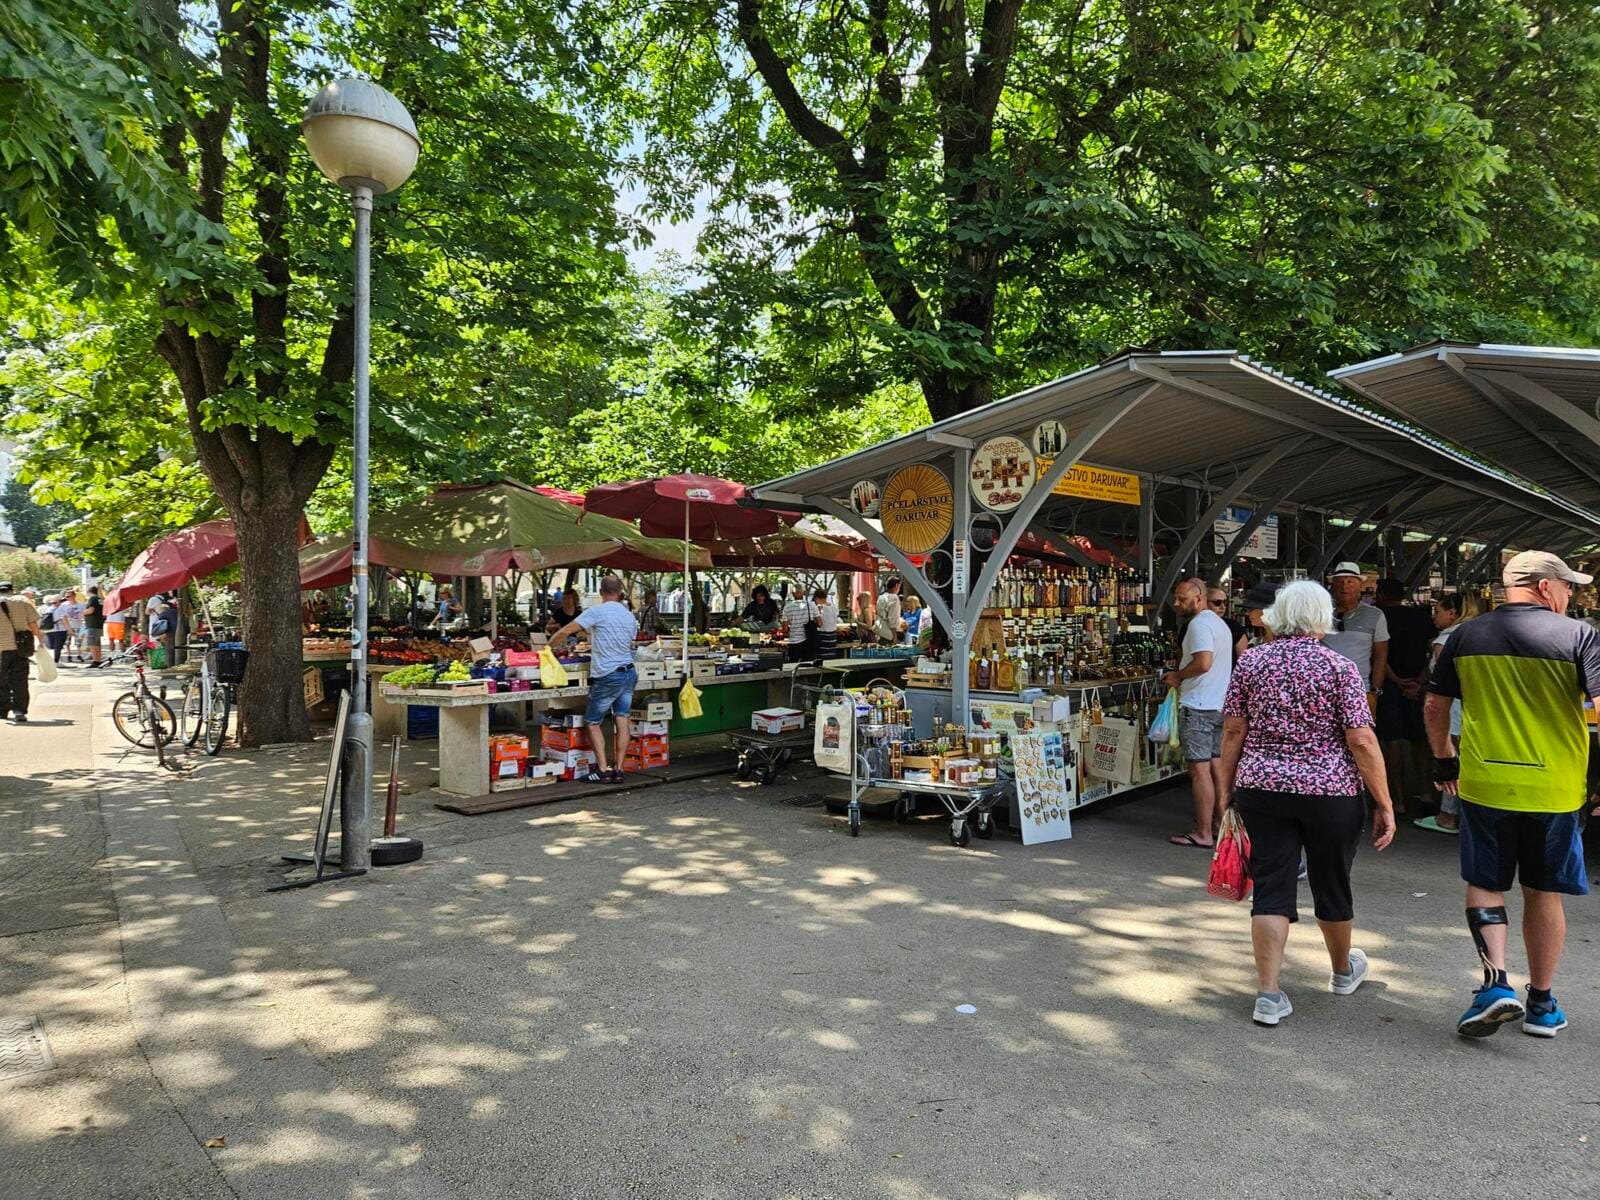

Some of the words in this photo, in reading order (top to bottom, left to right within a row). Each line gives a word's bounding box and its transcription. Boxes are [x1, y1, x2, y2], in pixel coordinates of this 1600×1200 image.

[887, 496, 947, 509] PČELARSTVO
[896, 511, 939, 522] DARUVAR
[1094, 743, 1117, 754] PULA!
